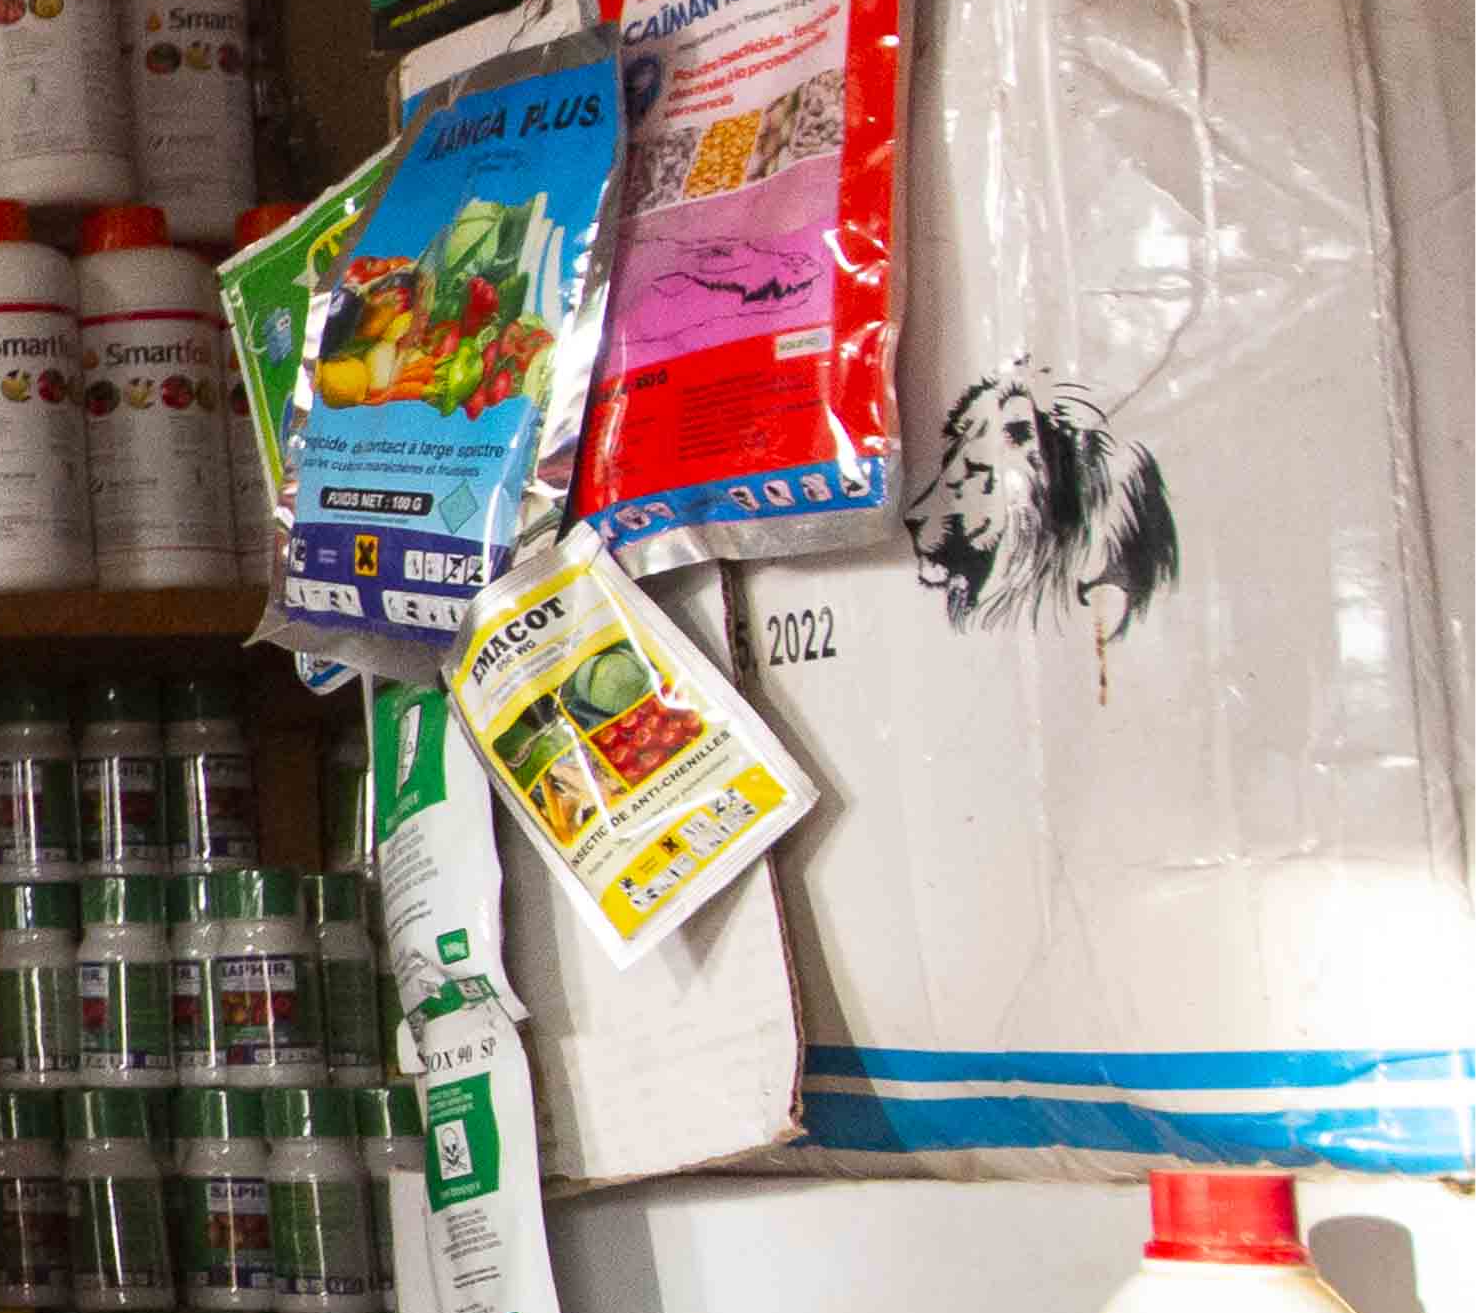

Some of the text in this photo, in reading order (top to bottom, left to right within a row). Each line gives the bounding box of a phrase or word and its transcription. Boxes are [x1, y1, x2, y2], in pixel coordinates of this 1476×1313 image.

[360, 492, 384, 507] NET
[412, 495, 423, 511] G
[470, 596, 569, 686] EMACOT
[767, 606, 837, 667] 2022
[631, 729, 732, 816] ANTI-CHENILLES
[479, 1037, 498, 1060] SP
